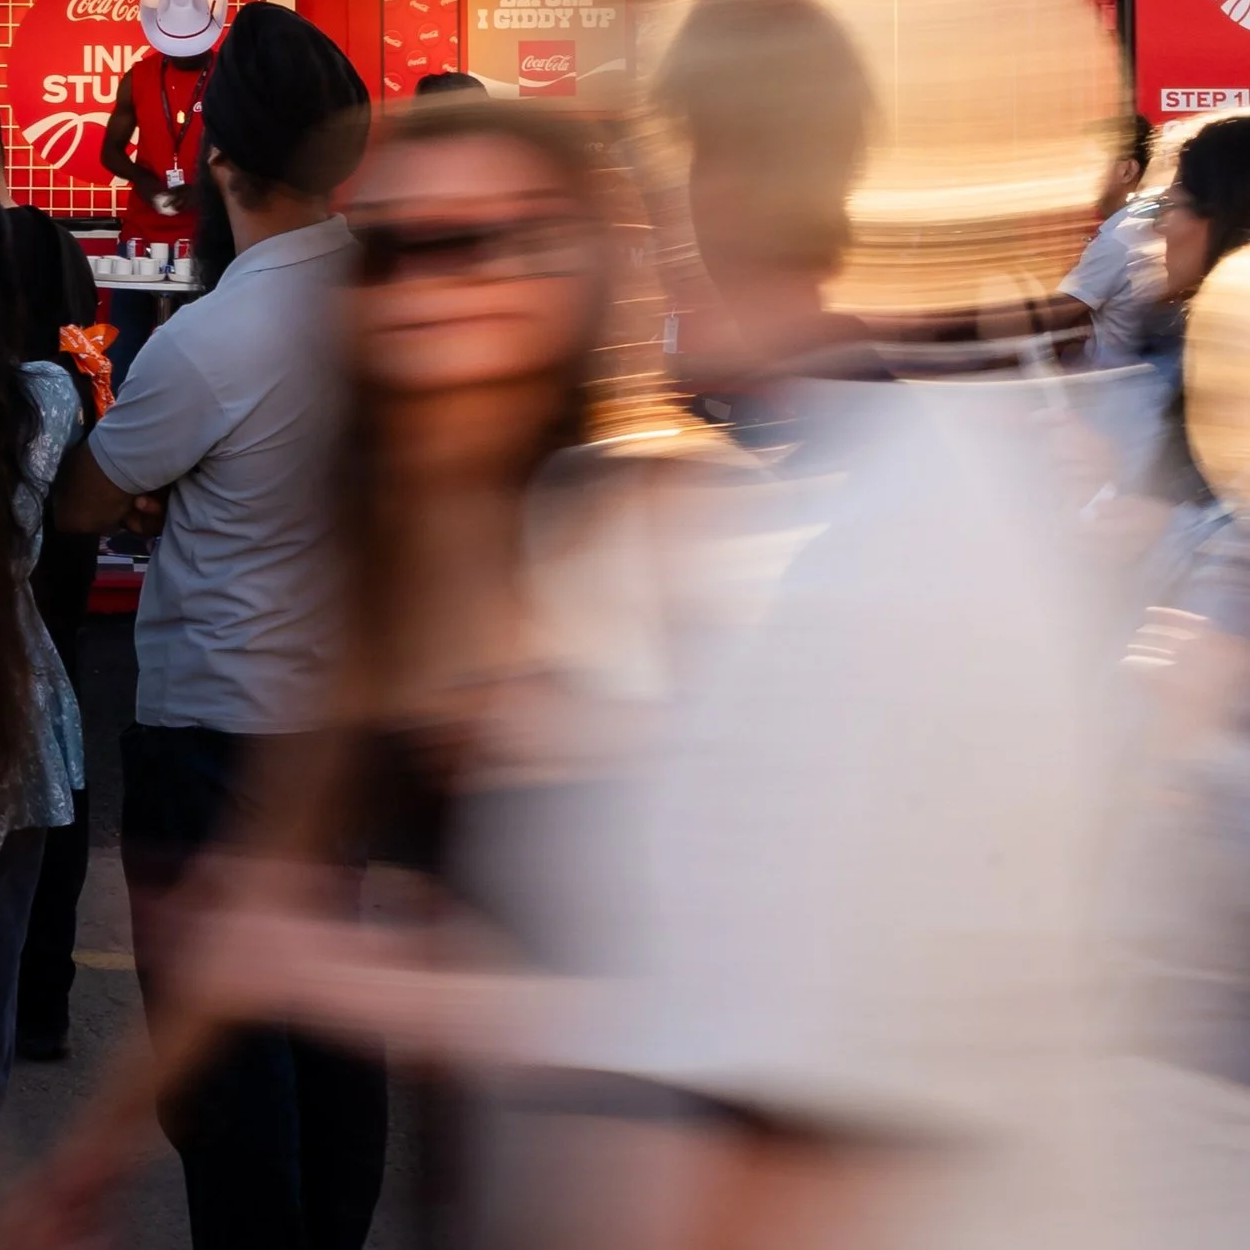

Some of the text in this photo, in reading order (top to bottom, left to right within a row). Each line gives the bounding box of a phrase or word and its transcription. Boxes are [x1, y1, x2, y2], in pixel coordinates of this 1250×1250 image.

[477, 7, 616, 29] I GIDDY UP
[1165, 91, 1243, 108] STEP 1
